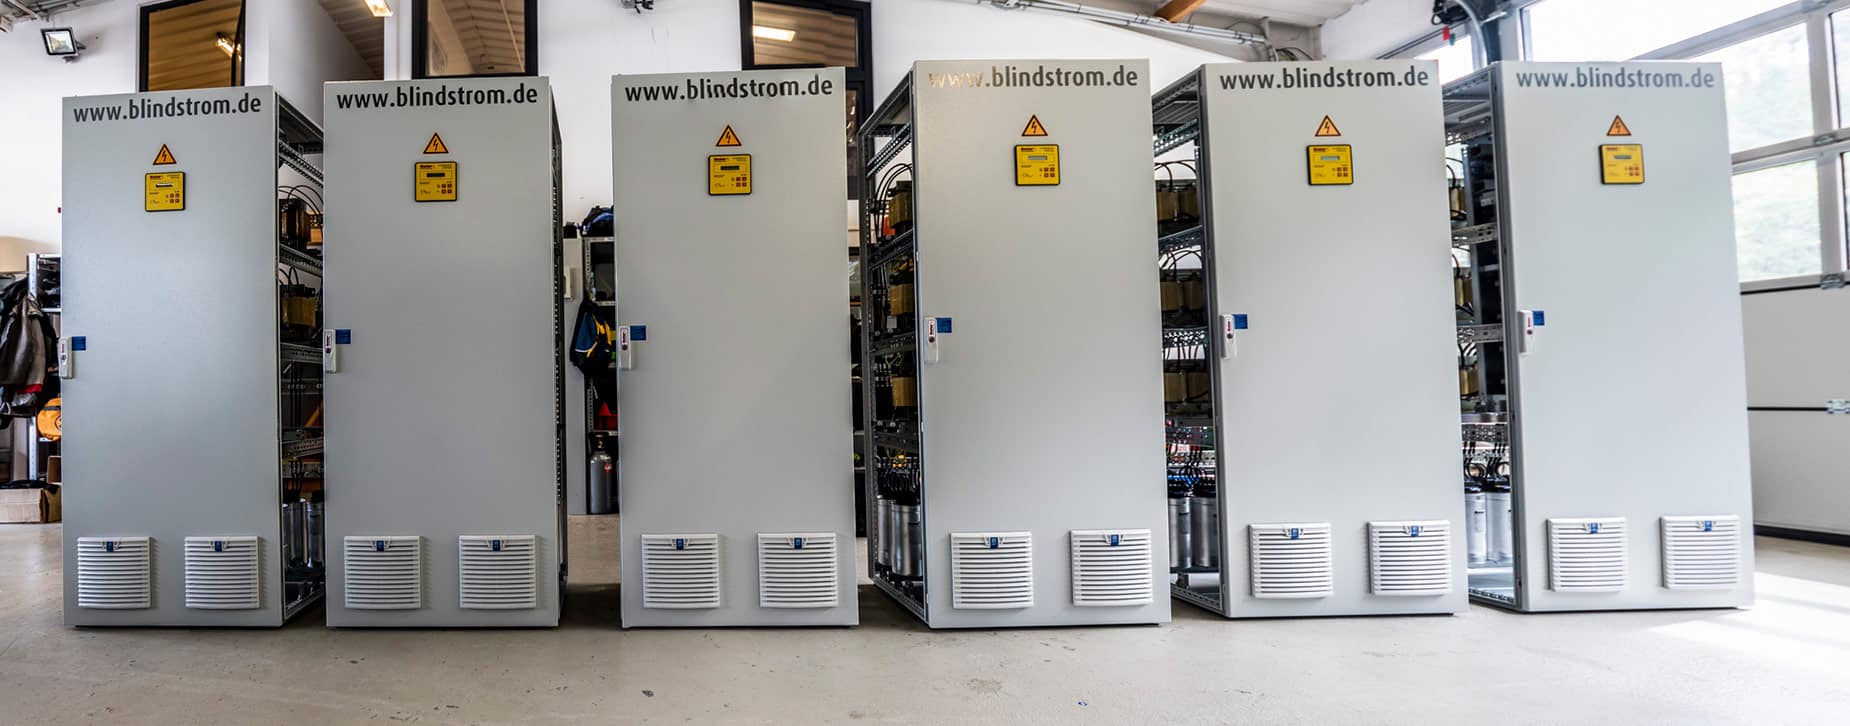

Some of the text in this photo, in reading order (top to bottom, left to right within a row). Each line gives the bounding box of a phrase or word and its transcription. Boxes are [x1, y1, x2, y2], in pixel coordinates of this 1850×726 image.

[625, 74, 833, 102] www.blindstrom.de
[928, 66, 1138, 89] www.blindstrom.de
[1219, 65, 1429, 90] www.blindstrom.de
[1516, 68, 1715, 88] www.blindstrom.de
[74, 93, 261, 122] www.blindstrom.de
[336, 83, 538, 109] www.blindstrom.de
